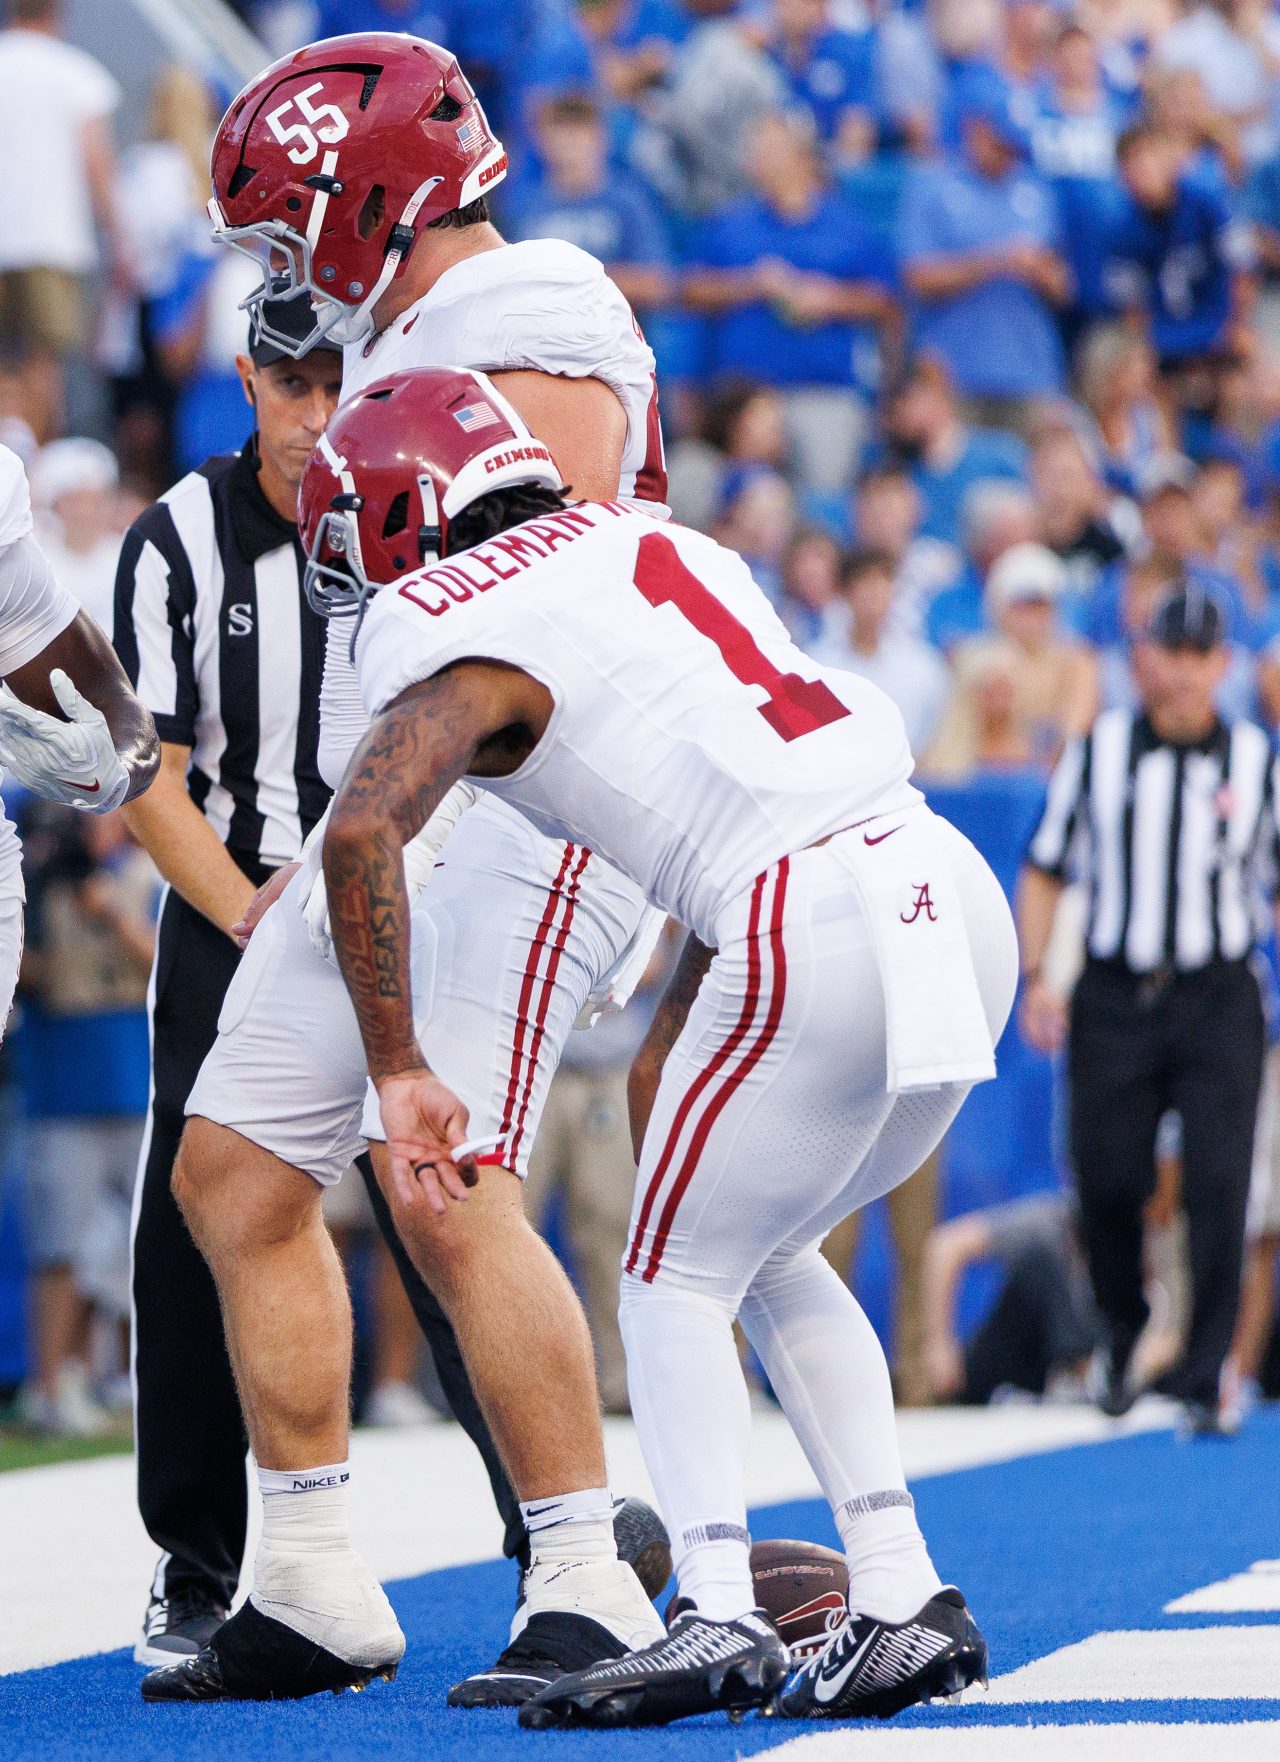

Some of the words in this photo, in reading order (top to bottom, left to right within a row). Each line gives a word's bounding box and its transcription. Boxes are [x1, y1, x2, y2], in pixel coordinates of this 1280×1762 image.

[265, 81, 350, 165] 55
[484, 446, 549, 474] CRIMSON
[632, 531, 853, 744] 1
[900, 882, 938, 923] A
[369, 893, 402, 998] BEAST
[293, 1476, 337, 1490] NIKE
